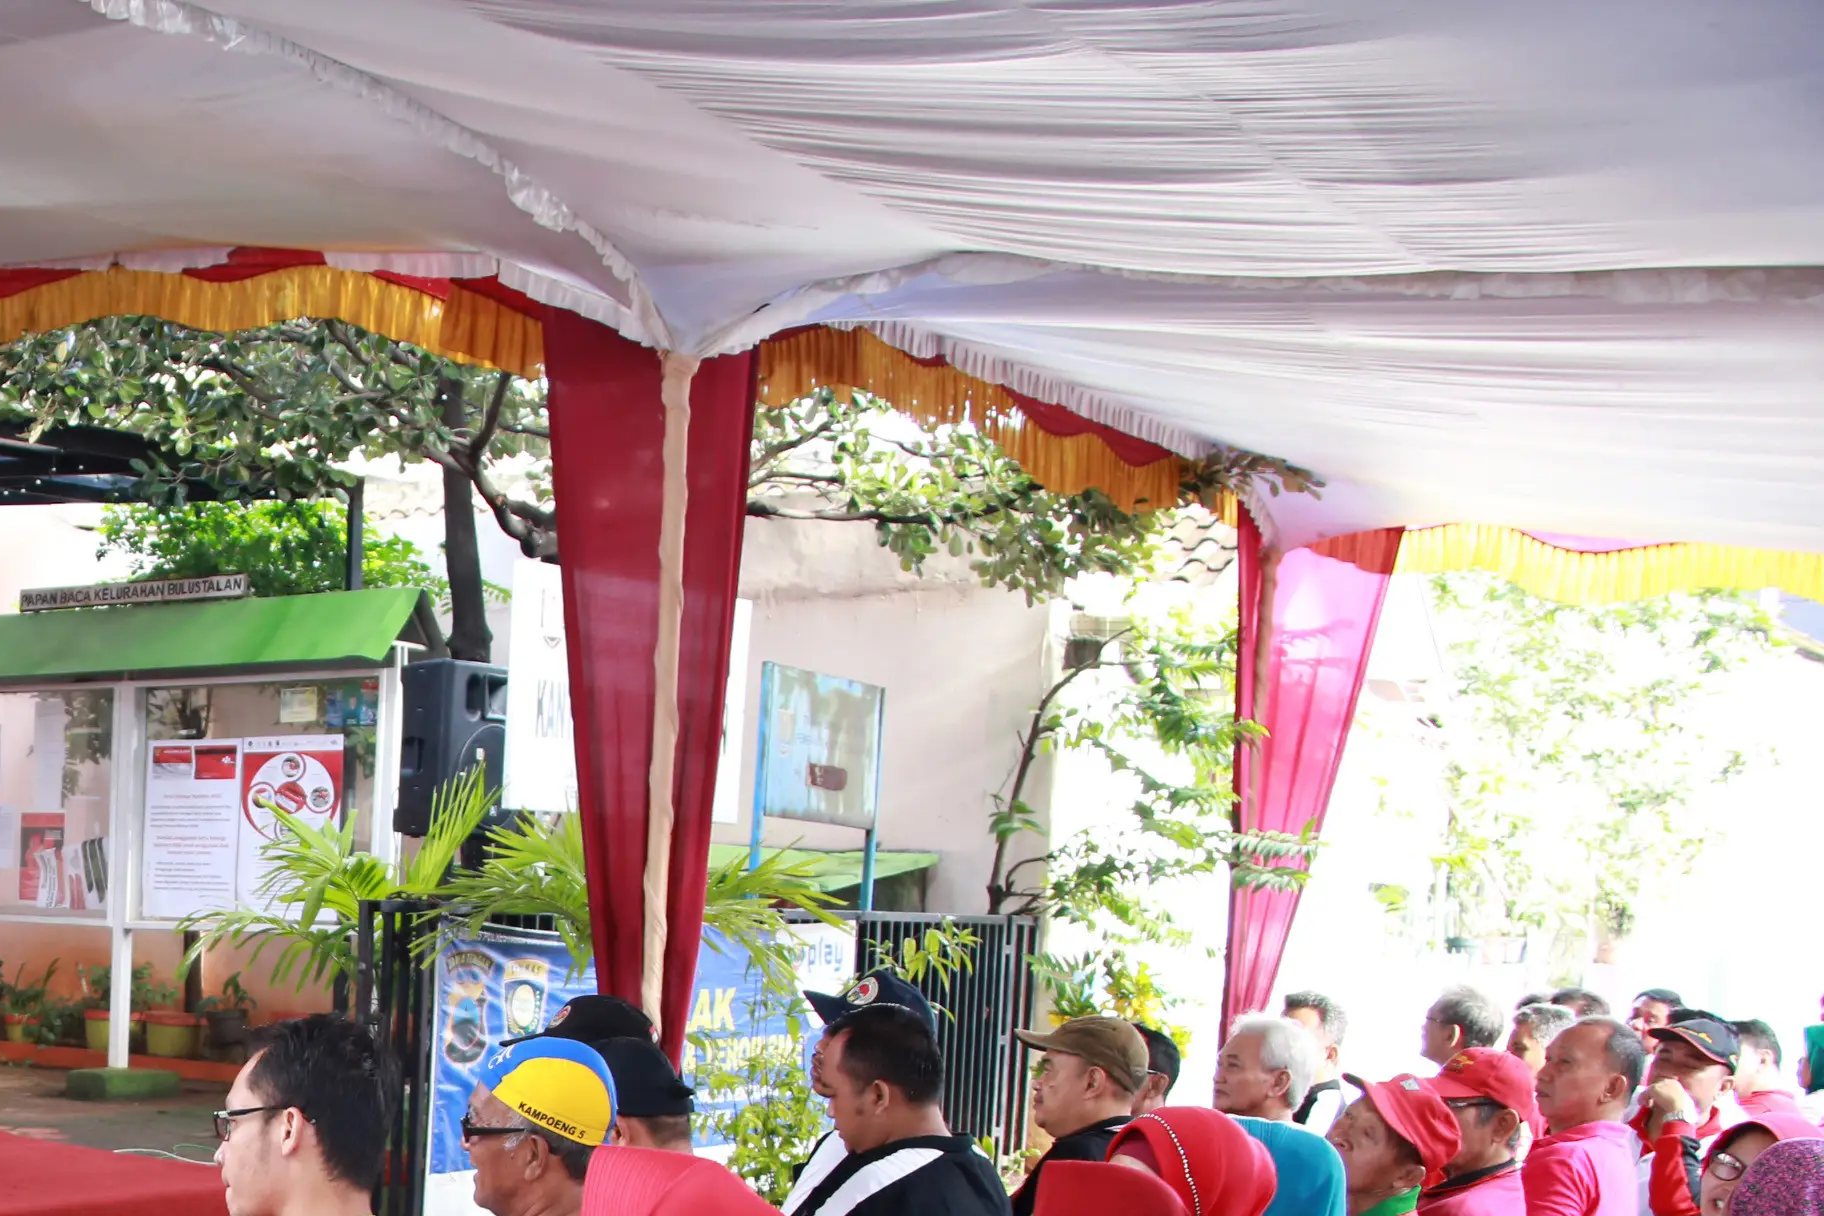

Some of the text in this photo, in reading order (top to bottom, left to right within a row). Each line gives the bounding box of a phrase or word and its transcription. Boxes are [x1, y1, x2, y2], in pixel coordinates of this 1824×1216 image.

[21, 577, 243, 607] PAPAN BACA KELURAHAN BULUSTALAN
[535, 678, 571, 740] KAN
[686, 987, 737, 1033] AK
[517, 1100, 587, 1140] KAMPOENG 5
